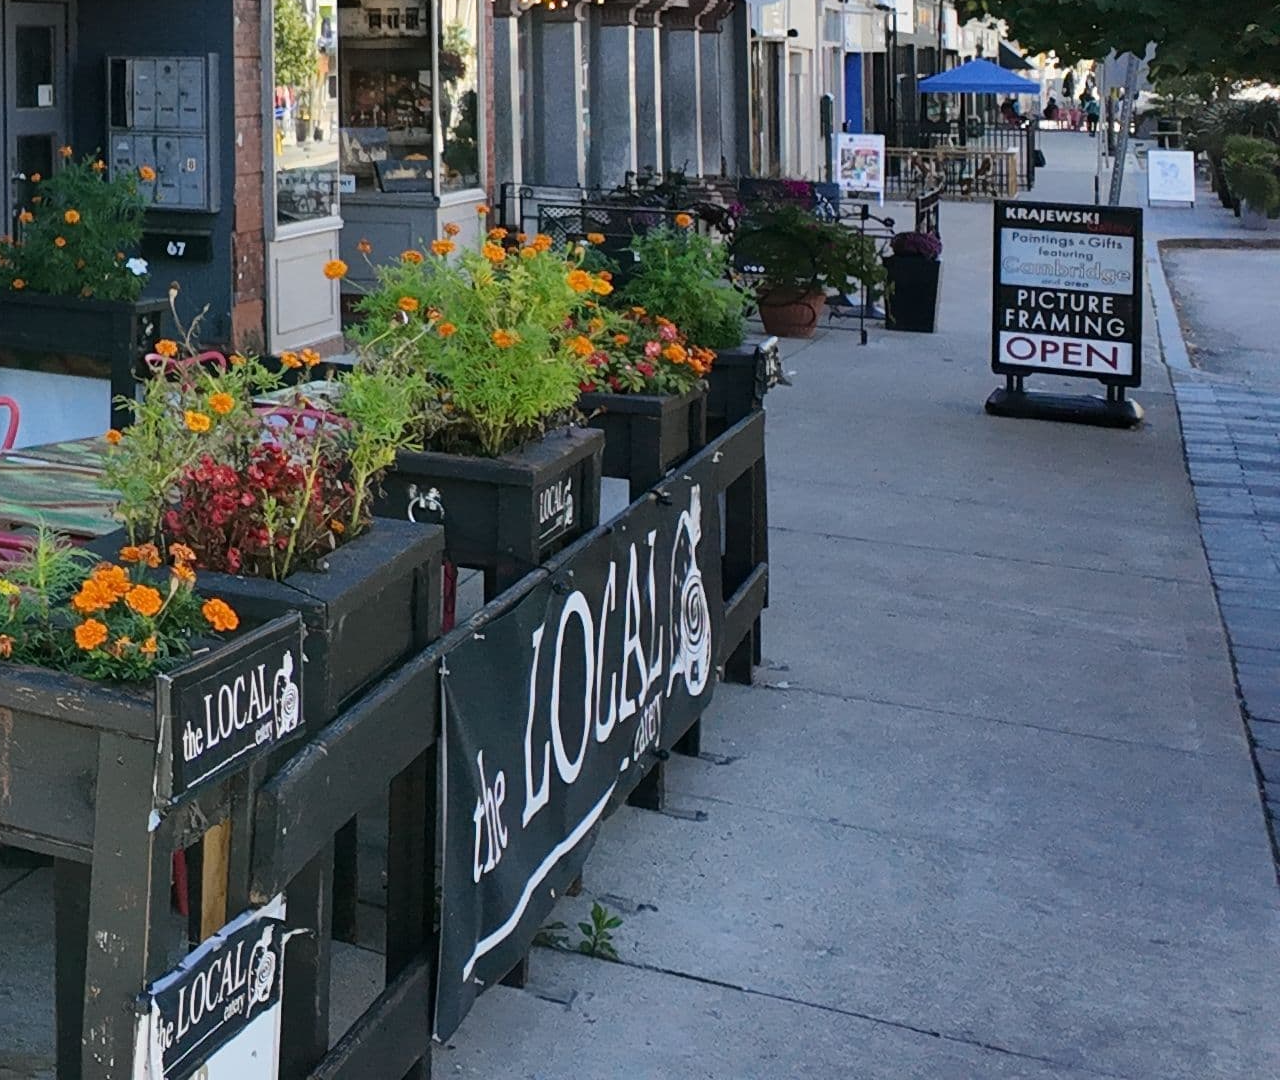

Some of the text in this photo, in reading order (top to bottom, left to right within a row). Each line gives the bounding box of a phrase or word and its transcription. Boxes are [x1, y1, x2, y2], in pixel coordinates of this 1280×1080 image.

[1005, 207, 1100, 225] KRAJEWSKI
[167, 241, 186, 257] 67
[1012, 231, 1074, 248] Paintings
[1088, 236, 1123, 250] Gifts
[1038, 246, 1094, 261] featuring
[1001, 256, 1131, 286] Cambridge
[1064, 280, 1089, 288] area
[1017, 289, 1114, 315] PICTURE
[1005, 308, 1125, 337] FRAMING
[1006, 336, 1119, 371] OPEN
[539, 480, 564, 524] LOCAL
[182, 663, 272, 762] the LOCAL
[472, 529, 664, 884] the LOCAL
[175, 940, 247, 1044] LOCAL
[223, 992, 246, 1022] eatery
